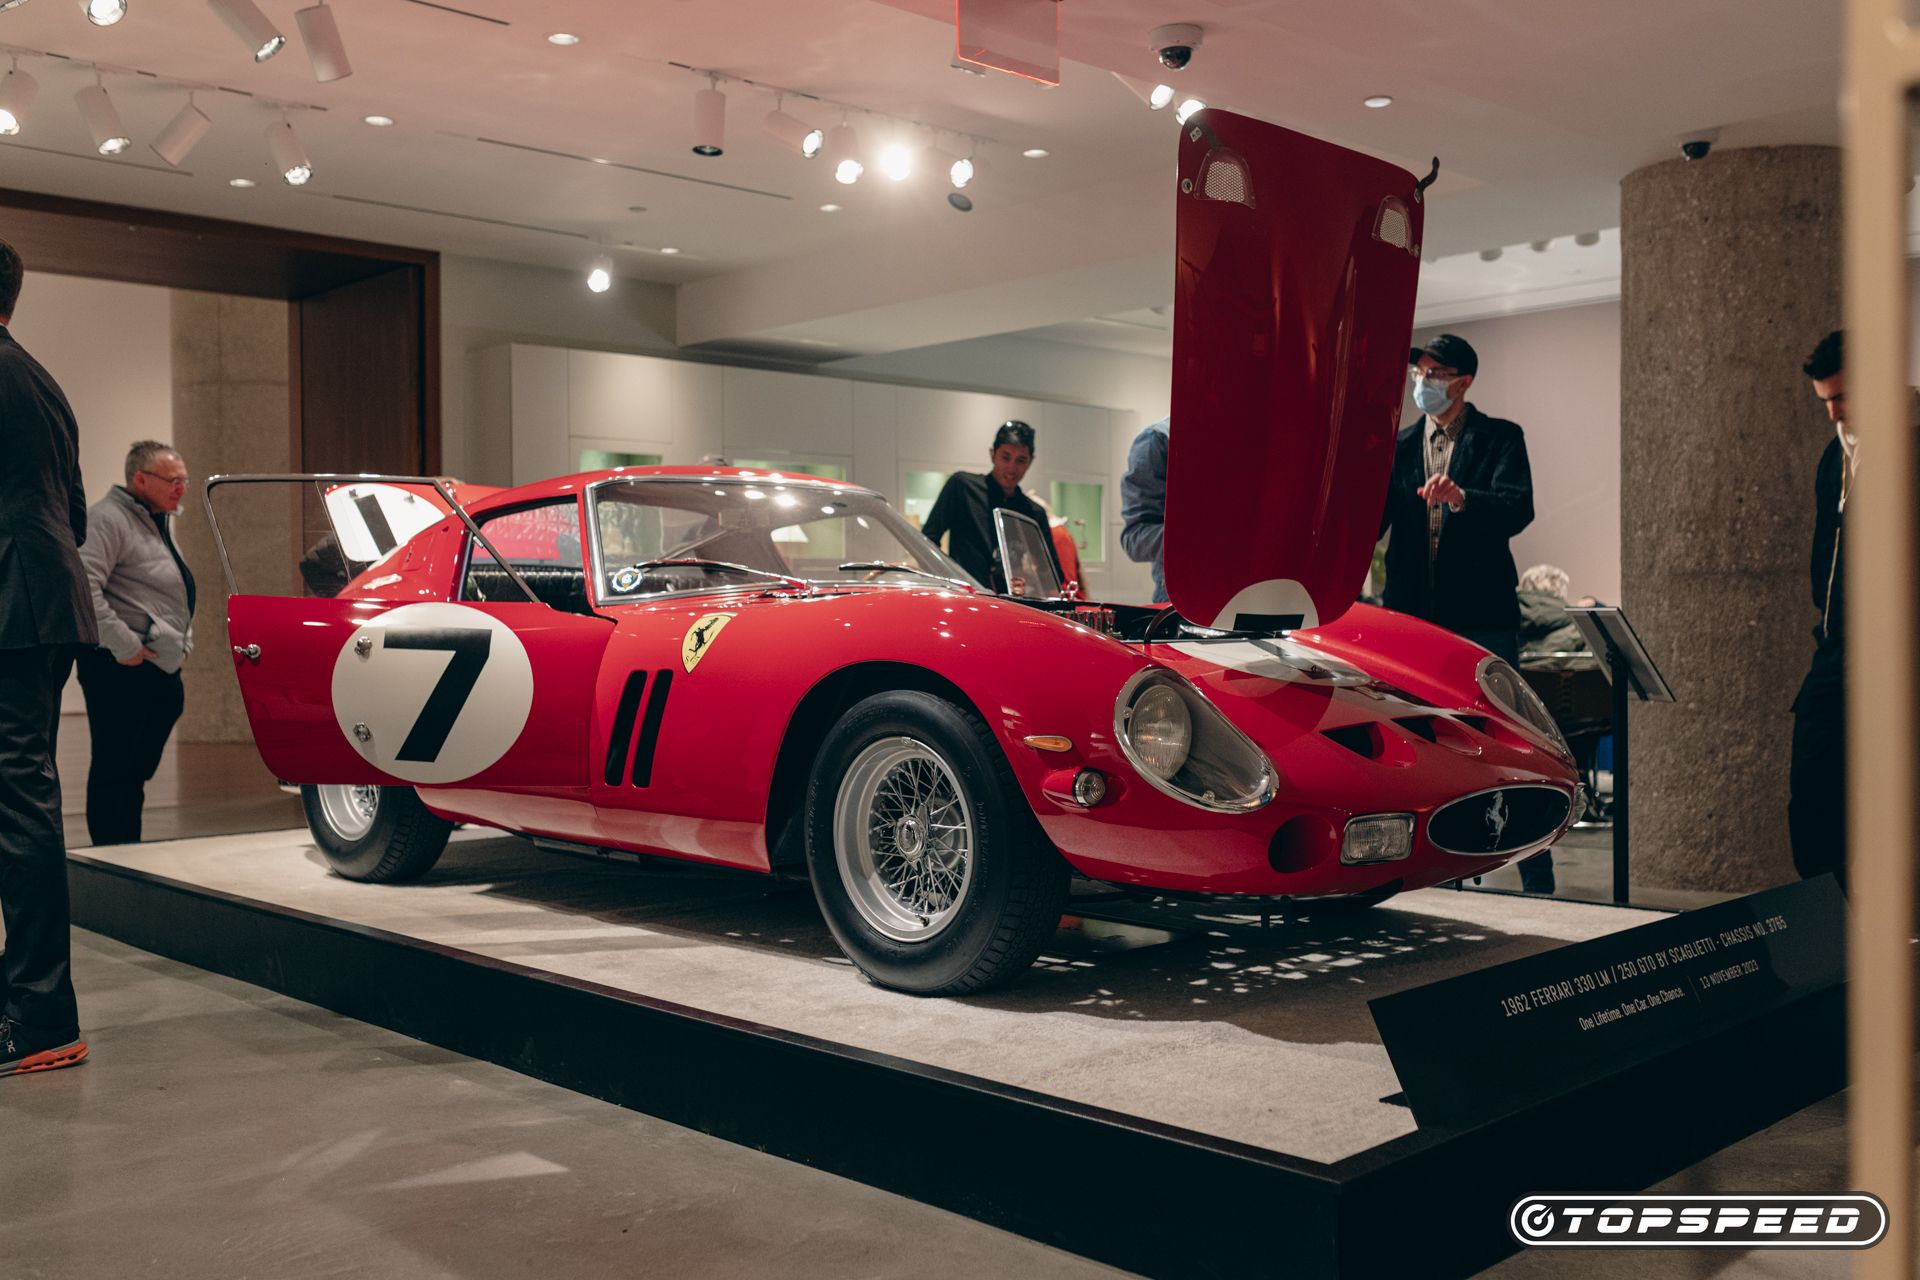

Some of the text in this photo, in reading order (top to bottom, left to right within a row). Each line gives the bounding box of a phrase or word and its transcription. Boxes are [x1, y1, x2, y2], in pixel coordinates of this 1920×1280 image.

[383, 627, 493, 763] 7
[1501, 994, 1532, 1017] 1962
[1530, 980, 1575, 1008] FERRARI
[1574, 974, 1596, 994] 330
[1595, 969, 1611, 987] LM
[1617, 961, 1638, 980] 250
[1637, 955, 1657, 974] GTO
[1656, 951, 1670, 968] BY
[1668, 937, 1717, 964] SCAGLIETTI
[1719, 925, 1754, 948] CHASSIS
[1753, 921, 1768, 937] NO.
[1766, 915, 1788, 933] 3765
[1700, 959, 1759, 989] 13 NOVEMBER 2023
[1578, 986, 1686, 1031] One Lifetime. One Car. One Chance.
